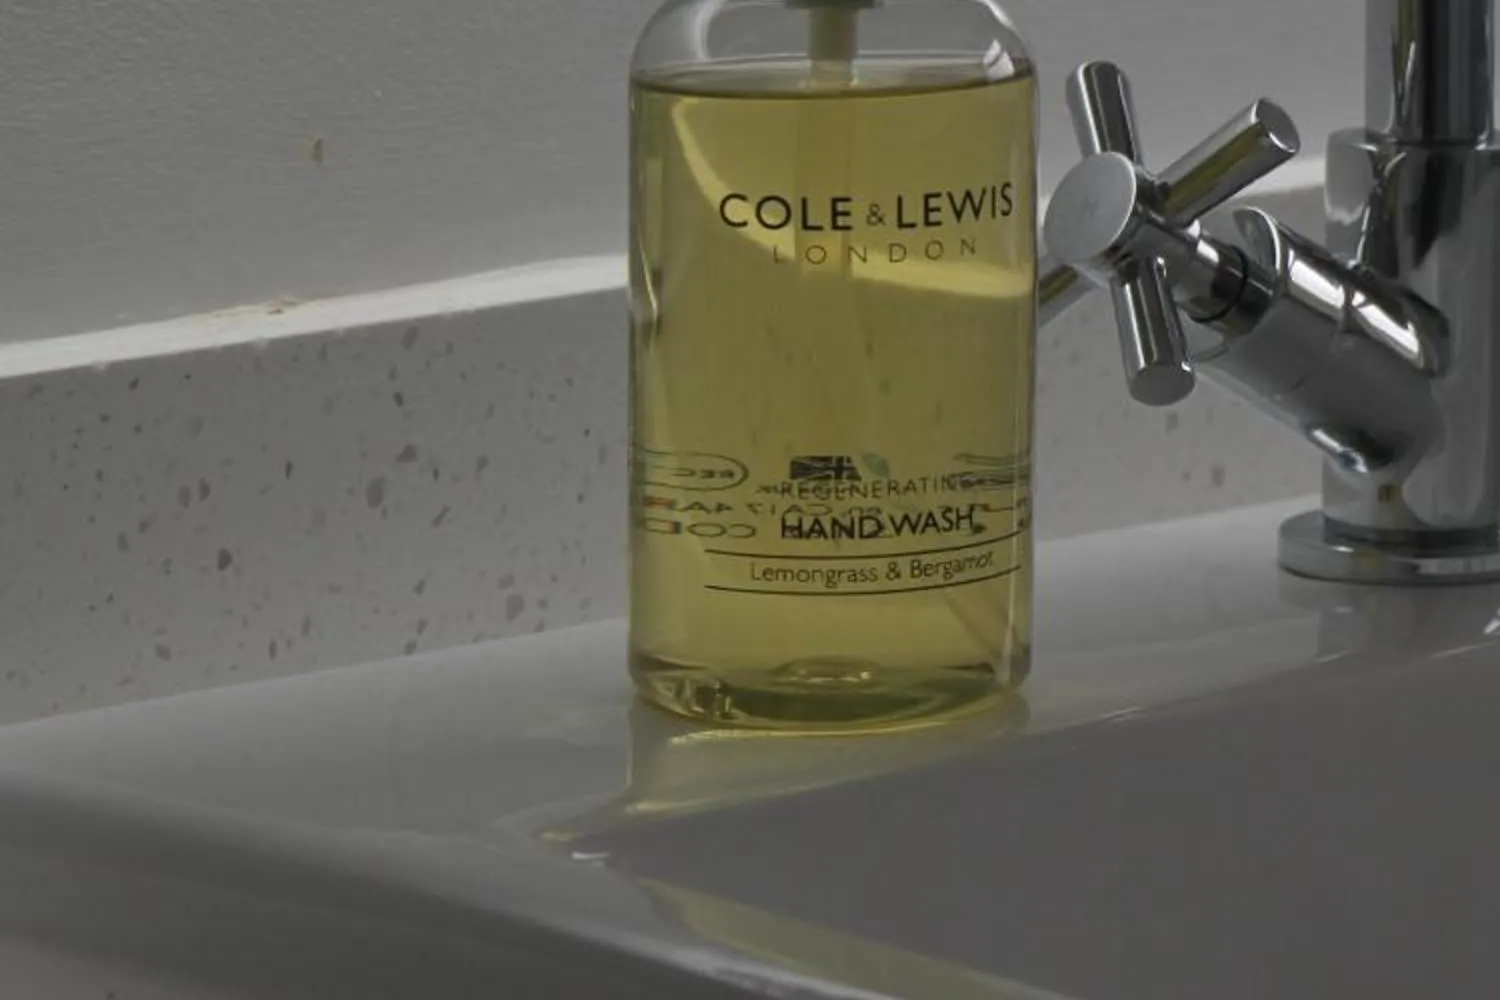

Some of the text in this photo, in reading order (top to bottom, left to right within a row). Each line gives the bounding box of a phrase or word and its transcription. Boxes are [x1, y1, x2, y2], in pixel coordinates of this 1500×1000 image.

[718, 181, 1014, 232] COLE & LEWIS
[772, 237, 977, 266] LONDON
[780, 514, 885, 540] HAND
[888, 504, 974, 537] WASH
[750, 551, 993, 588] Lemongrass & Bergamot
